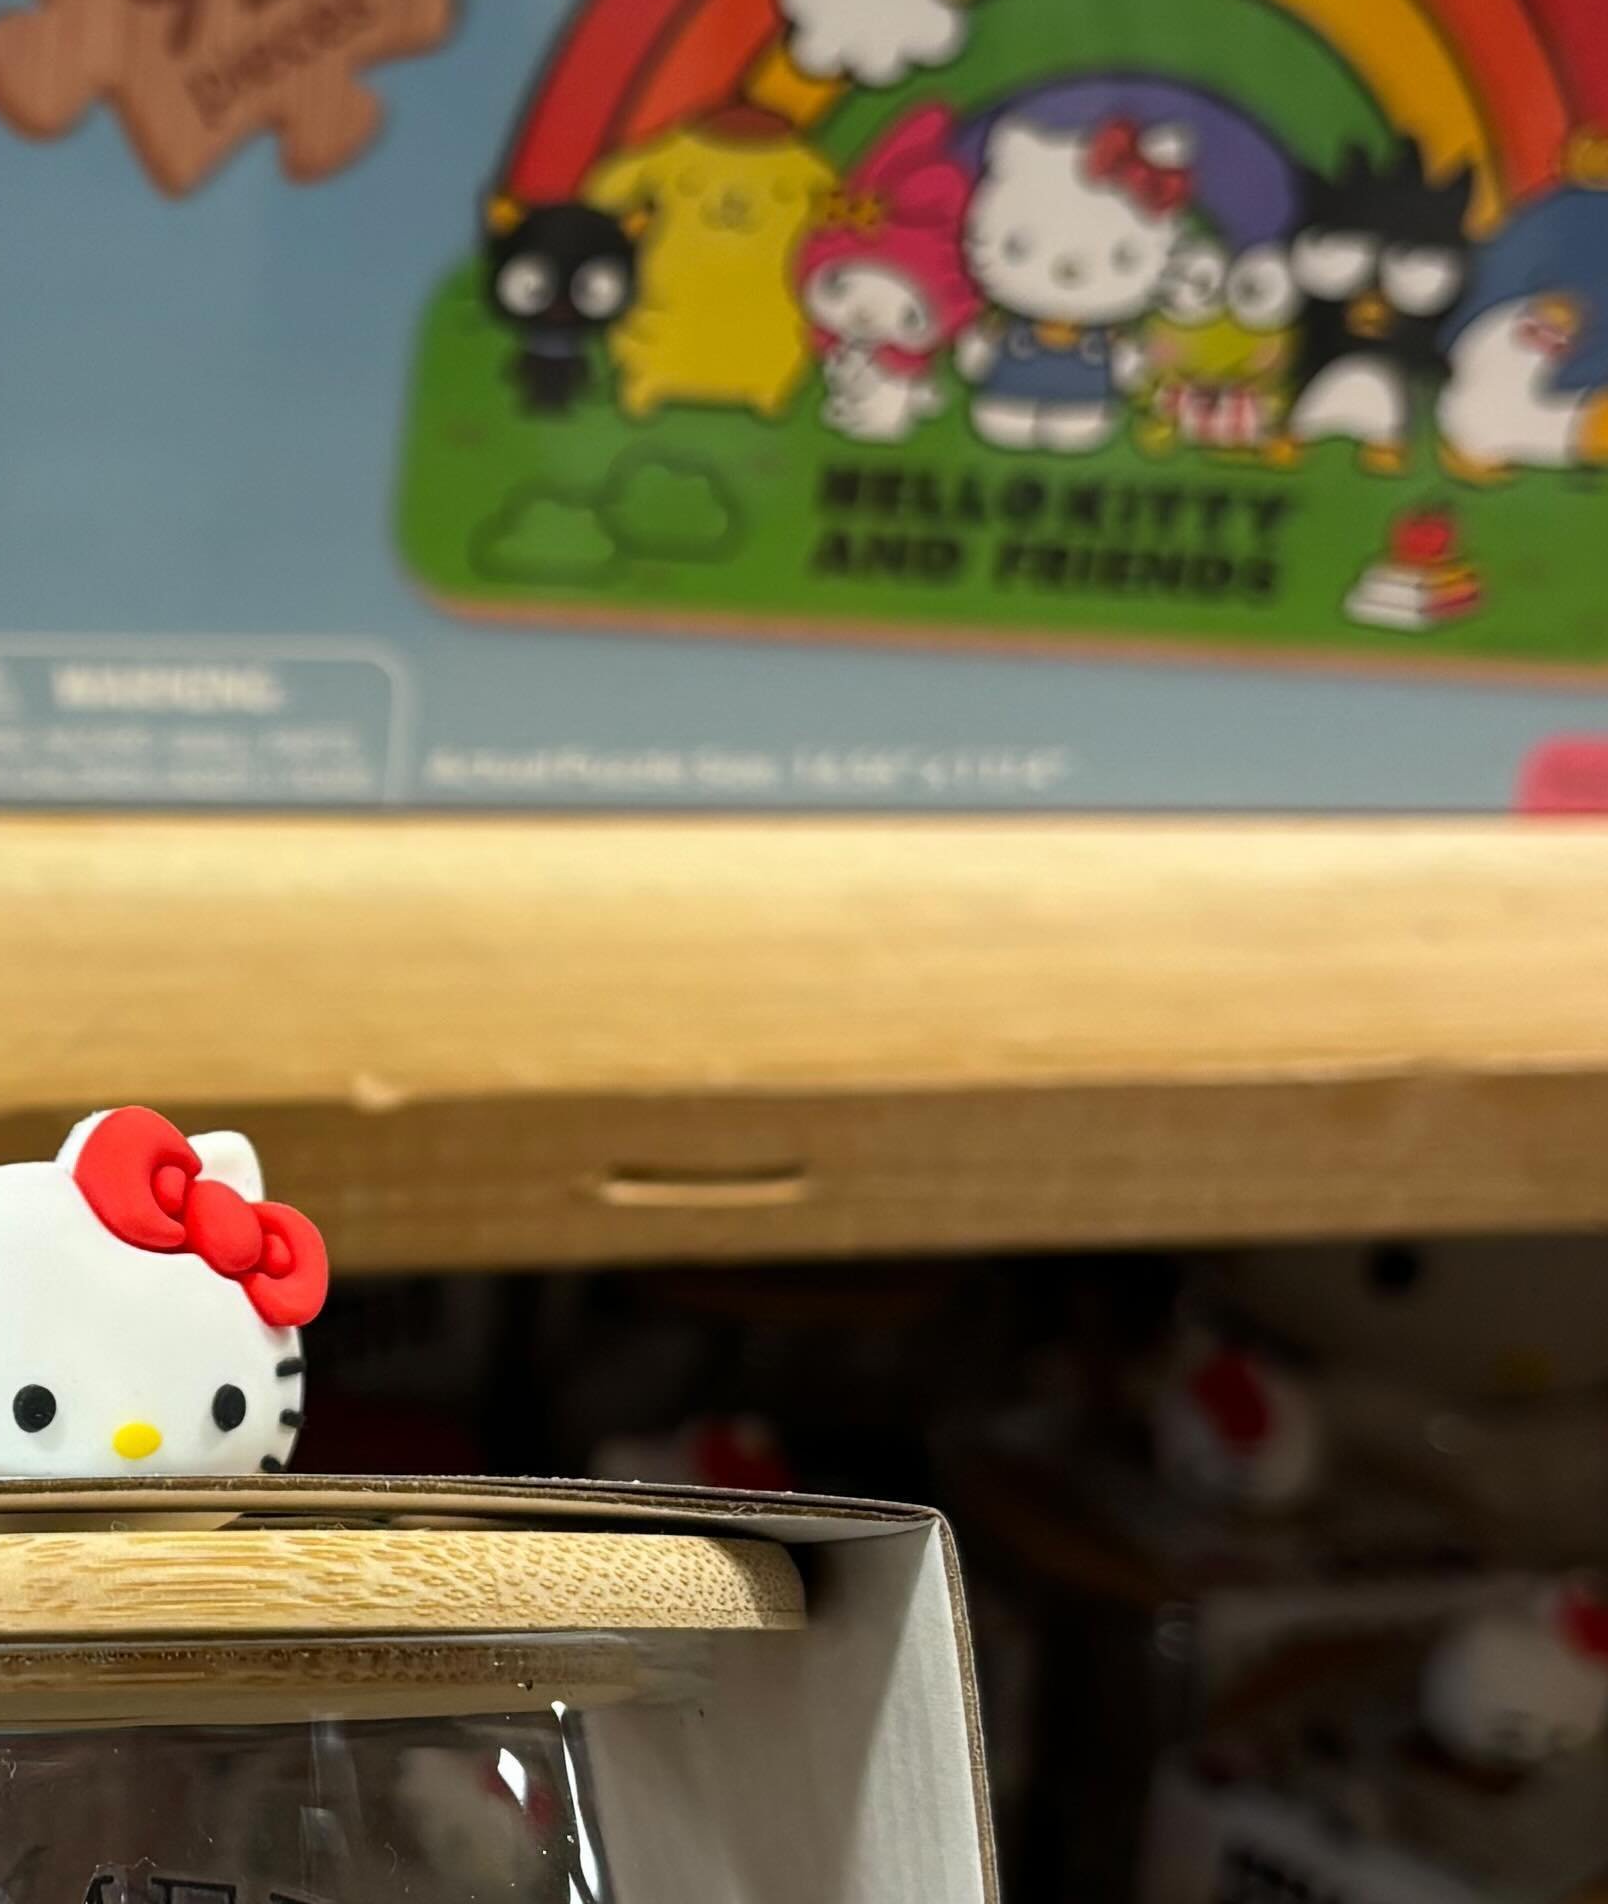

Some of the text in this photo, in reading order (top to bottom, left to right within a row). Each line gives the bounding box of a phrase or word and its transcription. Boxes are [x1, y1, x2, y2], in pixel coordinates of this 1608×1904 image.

[816, 465, 1292, 540] HELLO KITTY
[810, 530, 1280, 600] AND FRIENDS
